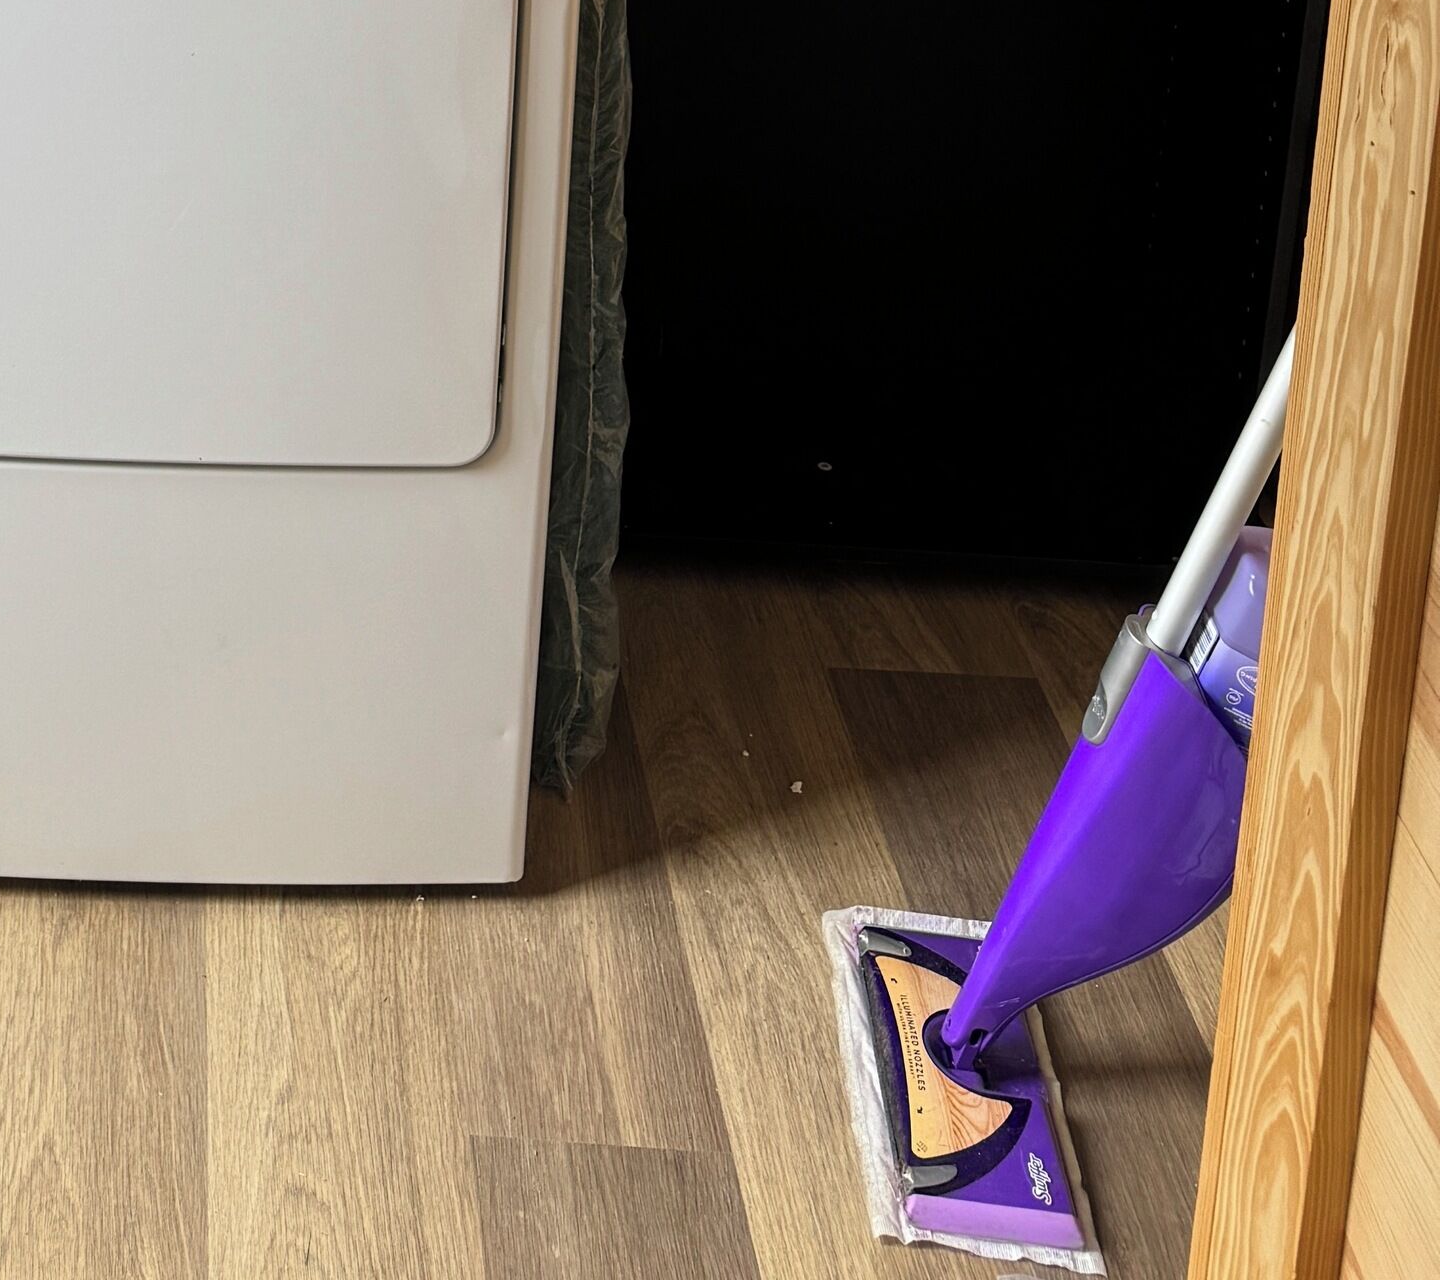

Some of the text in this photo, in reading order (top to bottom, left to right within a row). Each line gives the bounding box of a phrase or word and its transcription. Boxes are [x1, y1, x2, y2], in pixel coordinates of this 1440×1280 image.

[900, 994, 926, 1091] ILLUMINATED NOZZLES
[1027, 1152, 1052, 1206] Swiffer
